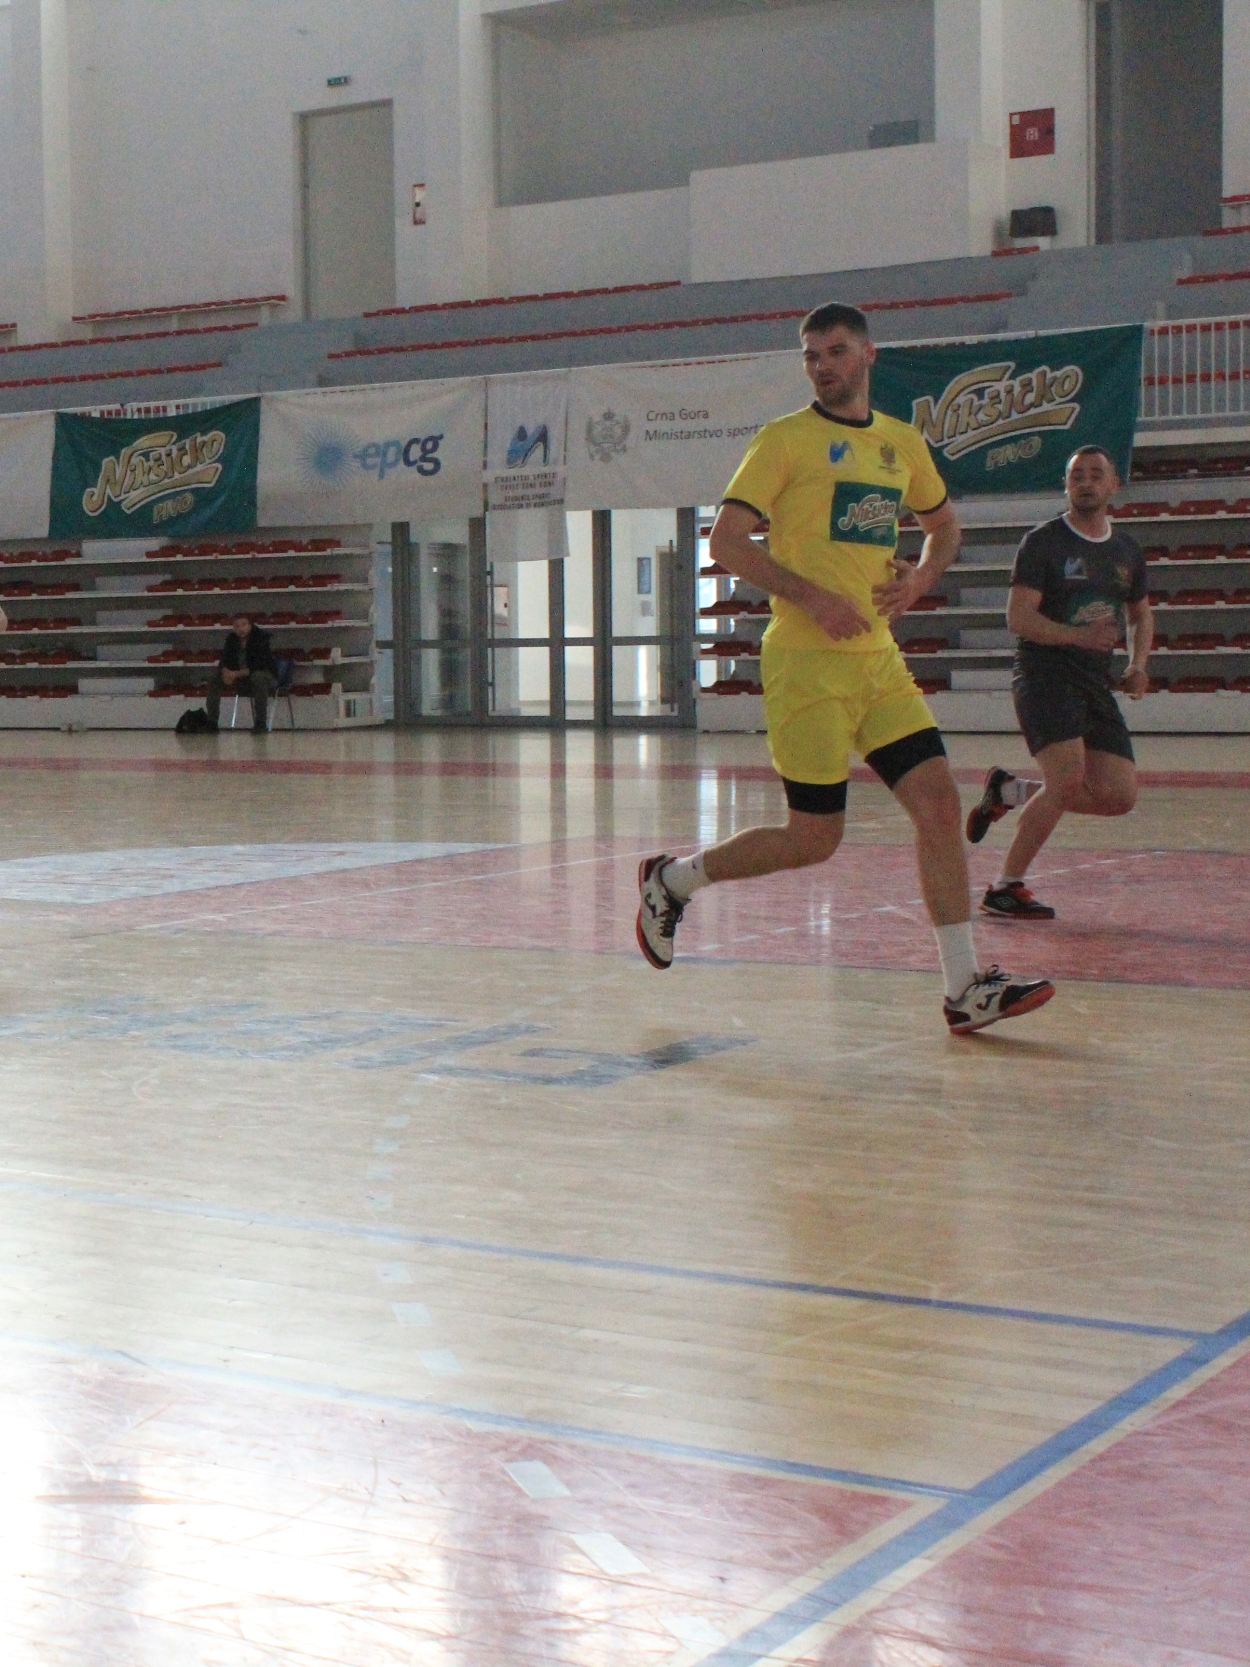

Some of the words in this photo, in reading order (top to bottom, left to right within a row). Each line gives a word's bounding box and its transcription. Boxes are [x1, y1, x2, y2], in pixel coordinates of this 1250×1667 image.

[646, 410, 676, 422] Crna
[678, 408, 710, 420] Gora
[644, 428, 723, 441] Ministarstvo
[352, 433, 444, 480] epcg
[985, 436, 1042, 471] PIVO
[153, 492, 194, 523] PIVO
